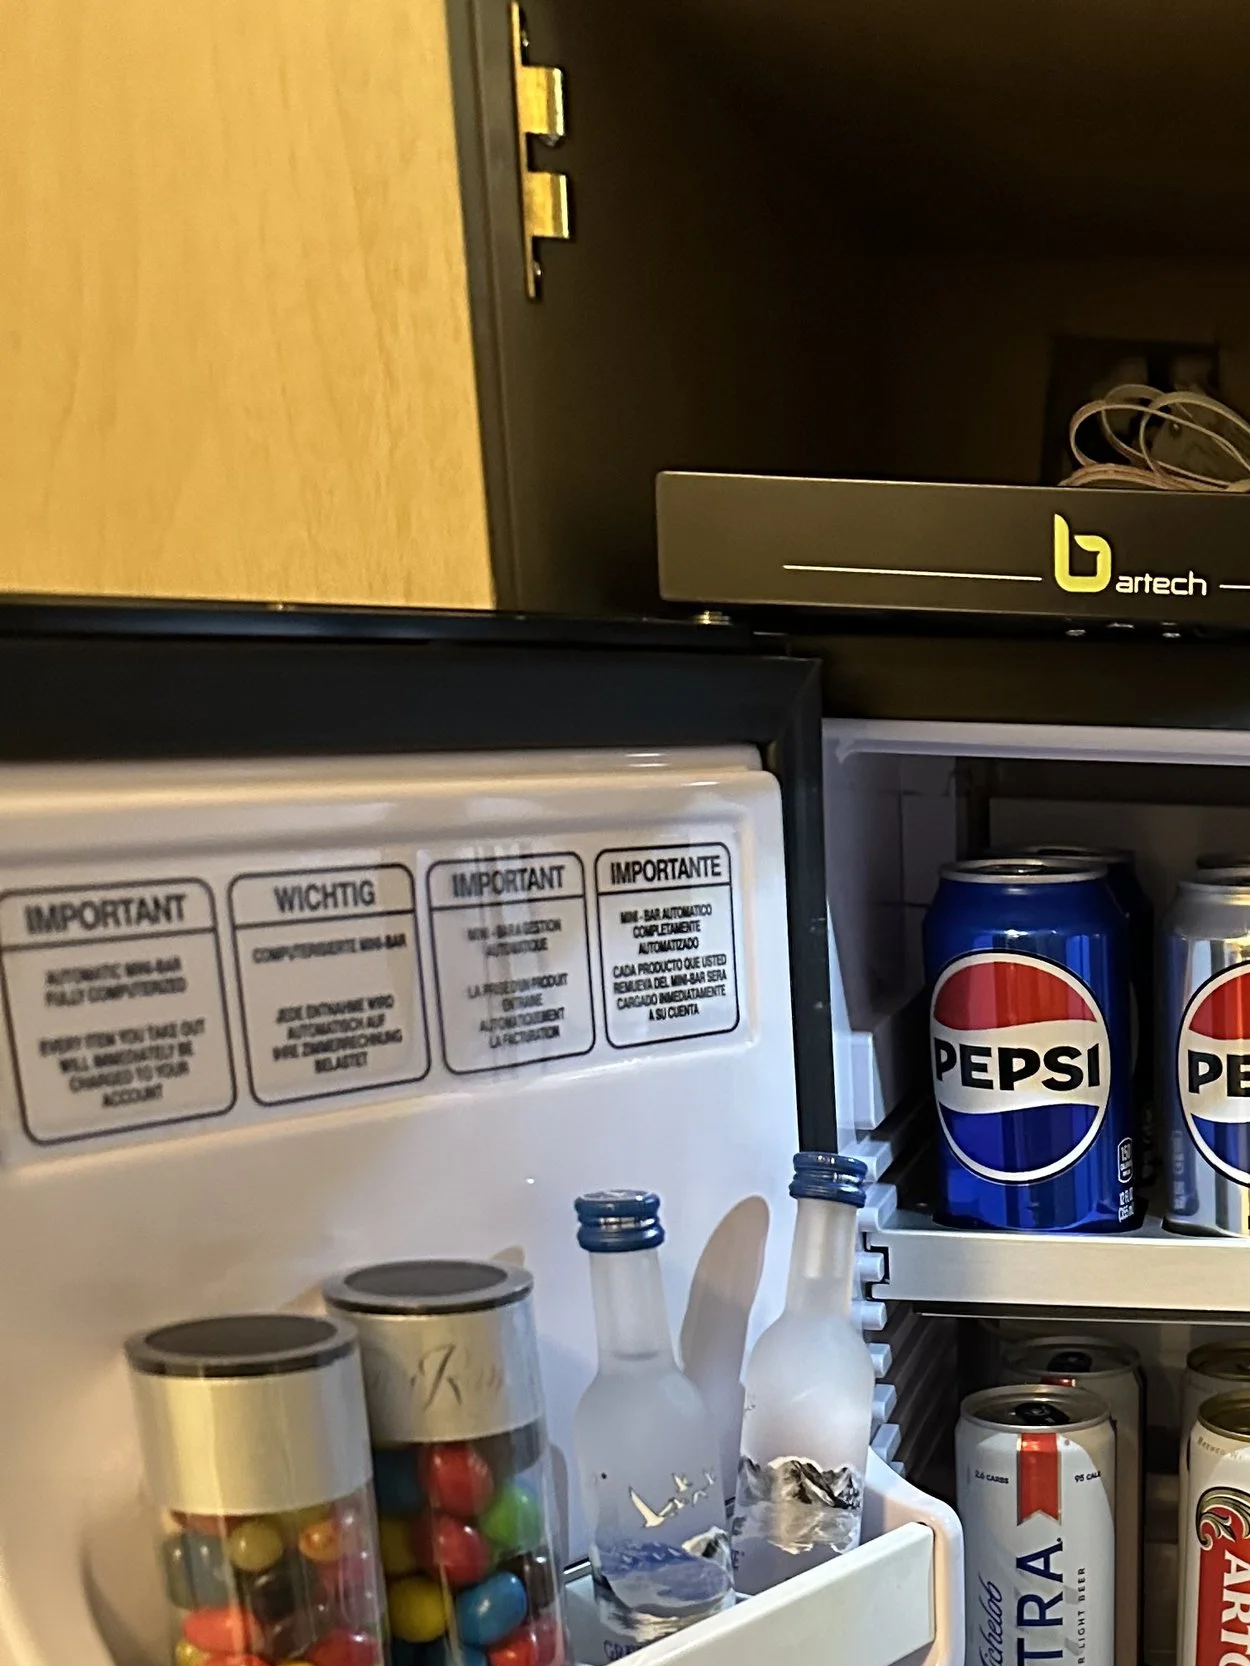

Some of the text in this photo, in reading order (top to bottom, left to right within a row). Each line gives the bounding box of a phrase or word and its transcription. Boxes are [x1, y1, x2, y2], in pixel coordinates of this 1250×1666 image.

[1053, 512, 1208, 597] bartech
[451, 864, 565, 898] IMPORTANT
[610, 855, 722, 885] IMPORTANTE
[24, 893, 187, 935] IMPORTANT
[273, 879, 376, 914] WICHTIG
[637, 958, 683, 976] PRODUCTO
[701, 953, 728, 968] USTED
[935, 1042, 1101, 1093] PEPSI
[1076, 1567, 1086, 1602] BEER
[1076, 1610, 1086, 1649] LIGHT
